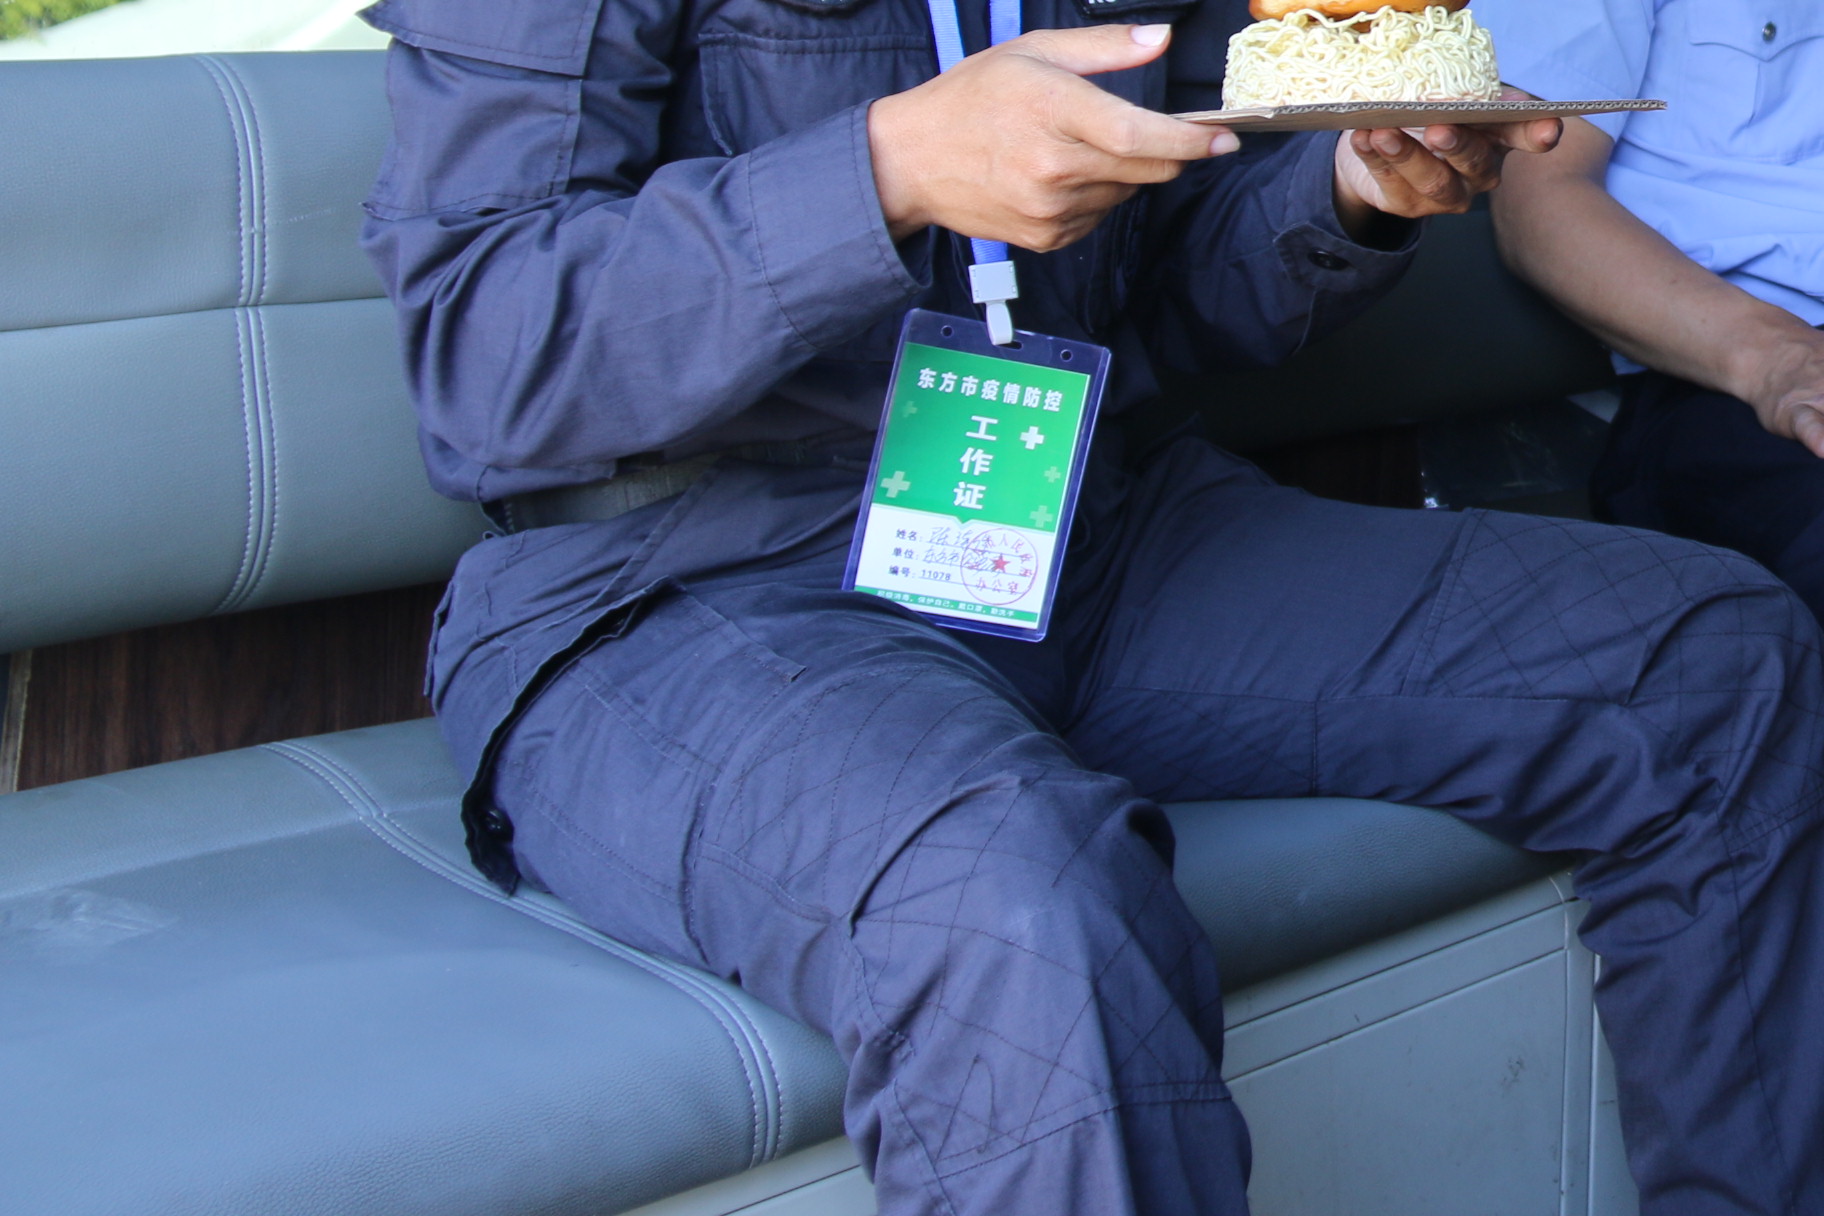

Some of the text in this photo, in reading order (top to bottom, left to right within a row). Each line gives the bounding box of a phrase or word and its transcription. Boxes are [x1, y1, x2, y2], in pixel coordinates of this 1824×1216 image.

[916, 367, 1064, 413] 东方市疫情防控
[952, 414, 999, 511] 工作证
[921, 569, 951, 582] 11078
